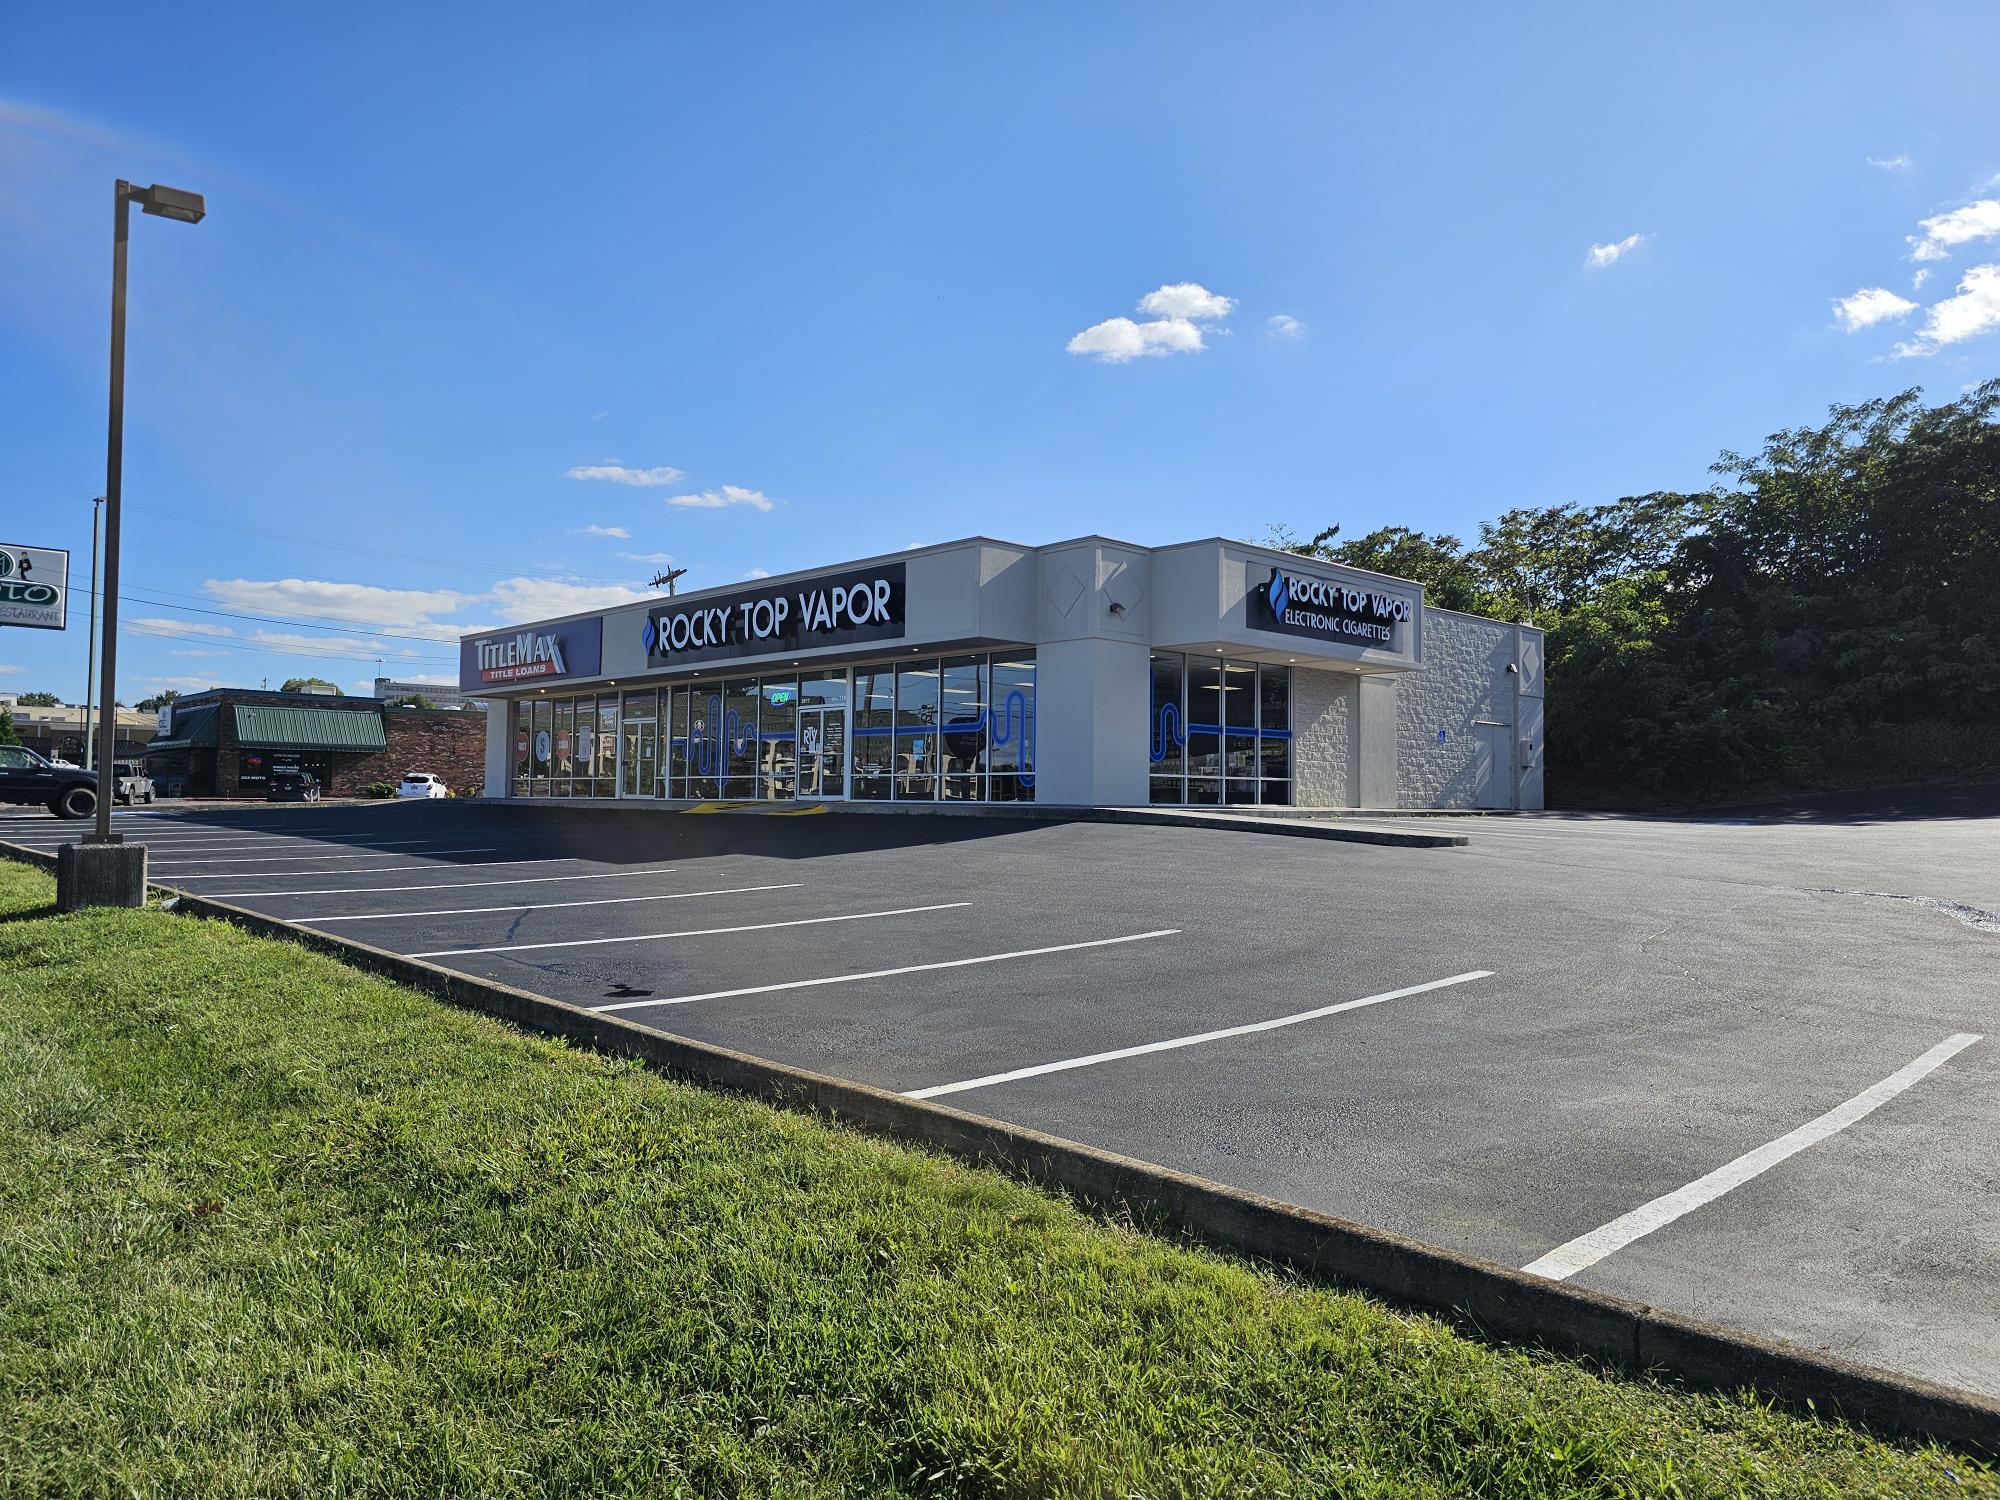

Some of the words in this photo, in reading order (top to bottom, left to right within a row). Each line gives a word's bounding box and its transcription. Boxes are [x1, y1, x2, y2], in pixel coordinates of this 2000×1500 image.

[659, 606, 731, 650] ROCKY
[740, 597, 789, 639] TOP
[799, 579, 891, 632] VAPOR
[1288, 575, 1337, 608] ROCKY
[1341, 590, 1367, 613] TOP
[1371, 593, 1411, 622] VAPOR
[1285, 608, 1340, 632] ELECTRONIC
[1342, 619, 1391, 641] CIGARETTES
[489, 669, 514, 680] TITLE
[515, 663, 547, 677] LOANS
[772, 691, 791, 703] OPEN
